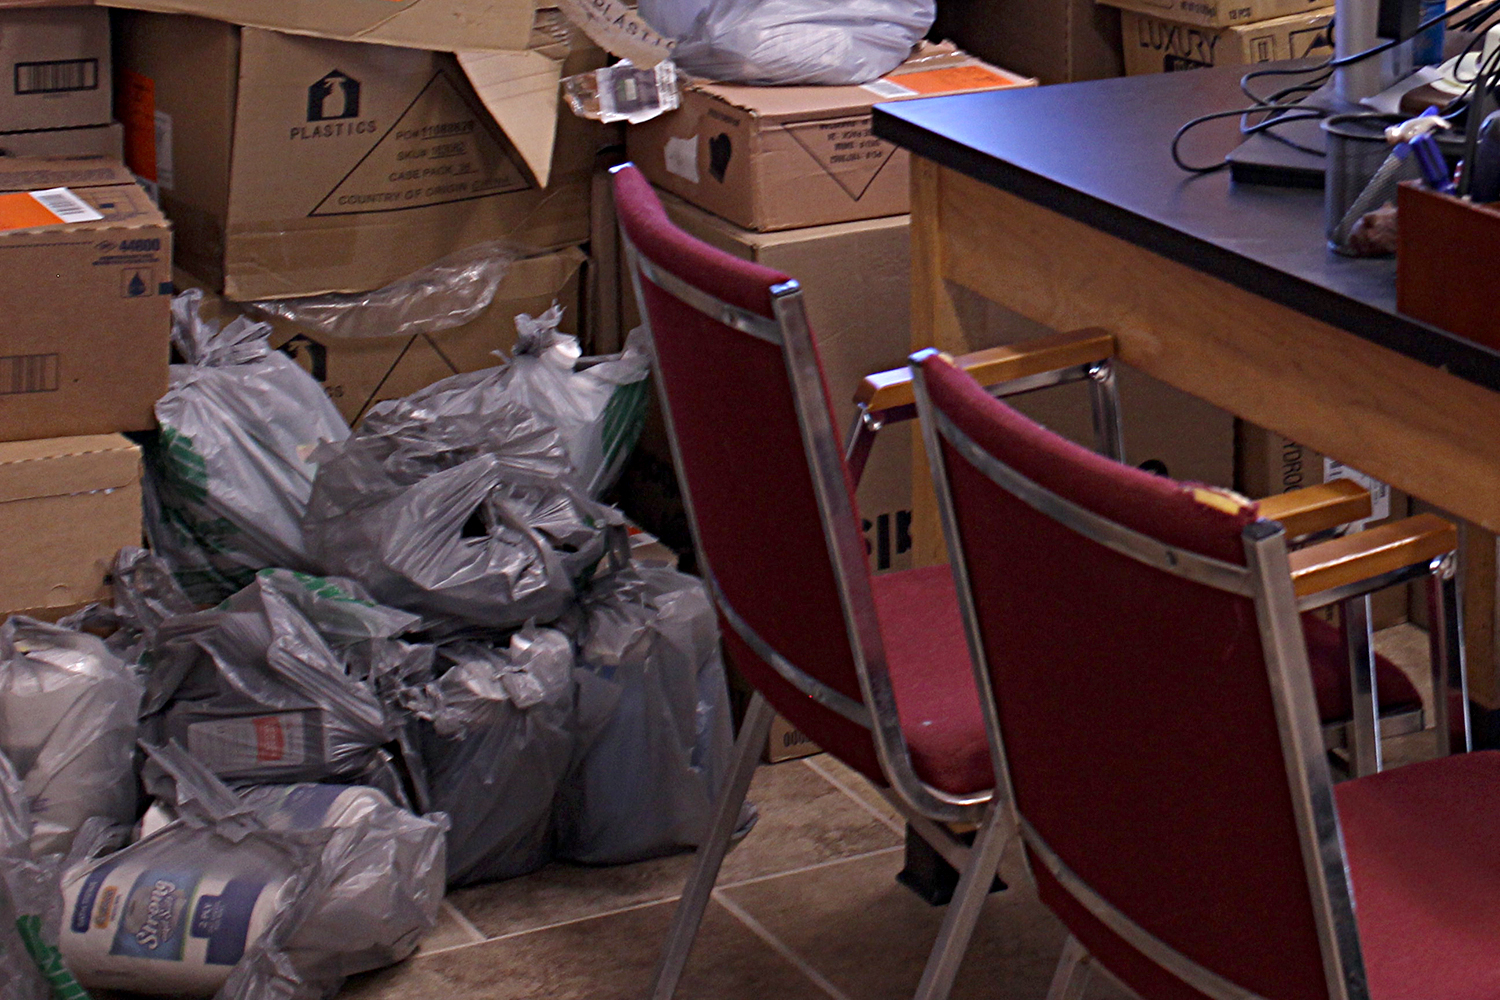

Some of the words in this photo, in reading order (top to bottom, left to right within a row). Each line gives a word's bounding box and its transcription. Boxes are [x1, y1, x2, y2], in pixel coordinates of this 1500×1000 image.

[1138, 18, 1219, 66] LUXURY
[290, 120, 377, 140] PLASTICS
[388, 170, 419, 183] CASE
[338, 191, 401, 206] COUNTRY
[403, 188, 422, 200] OF
[135, 879, 176, 950] Strong
